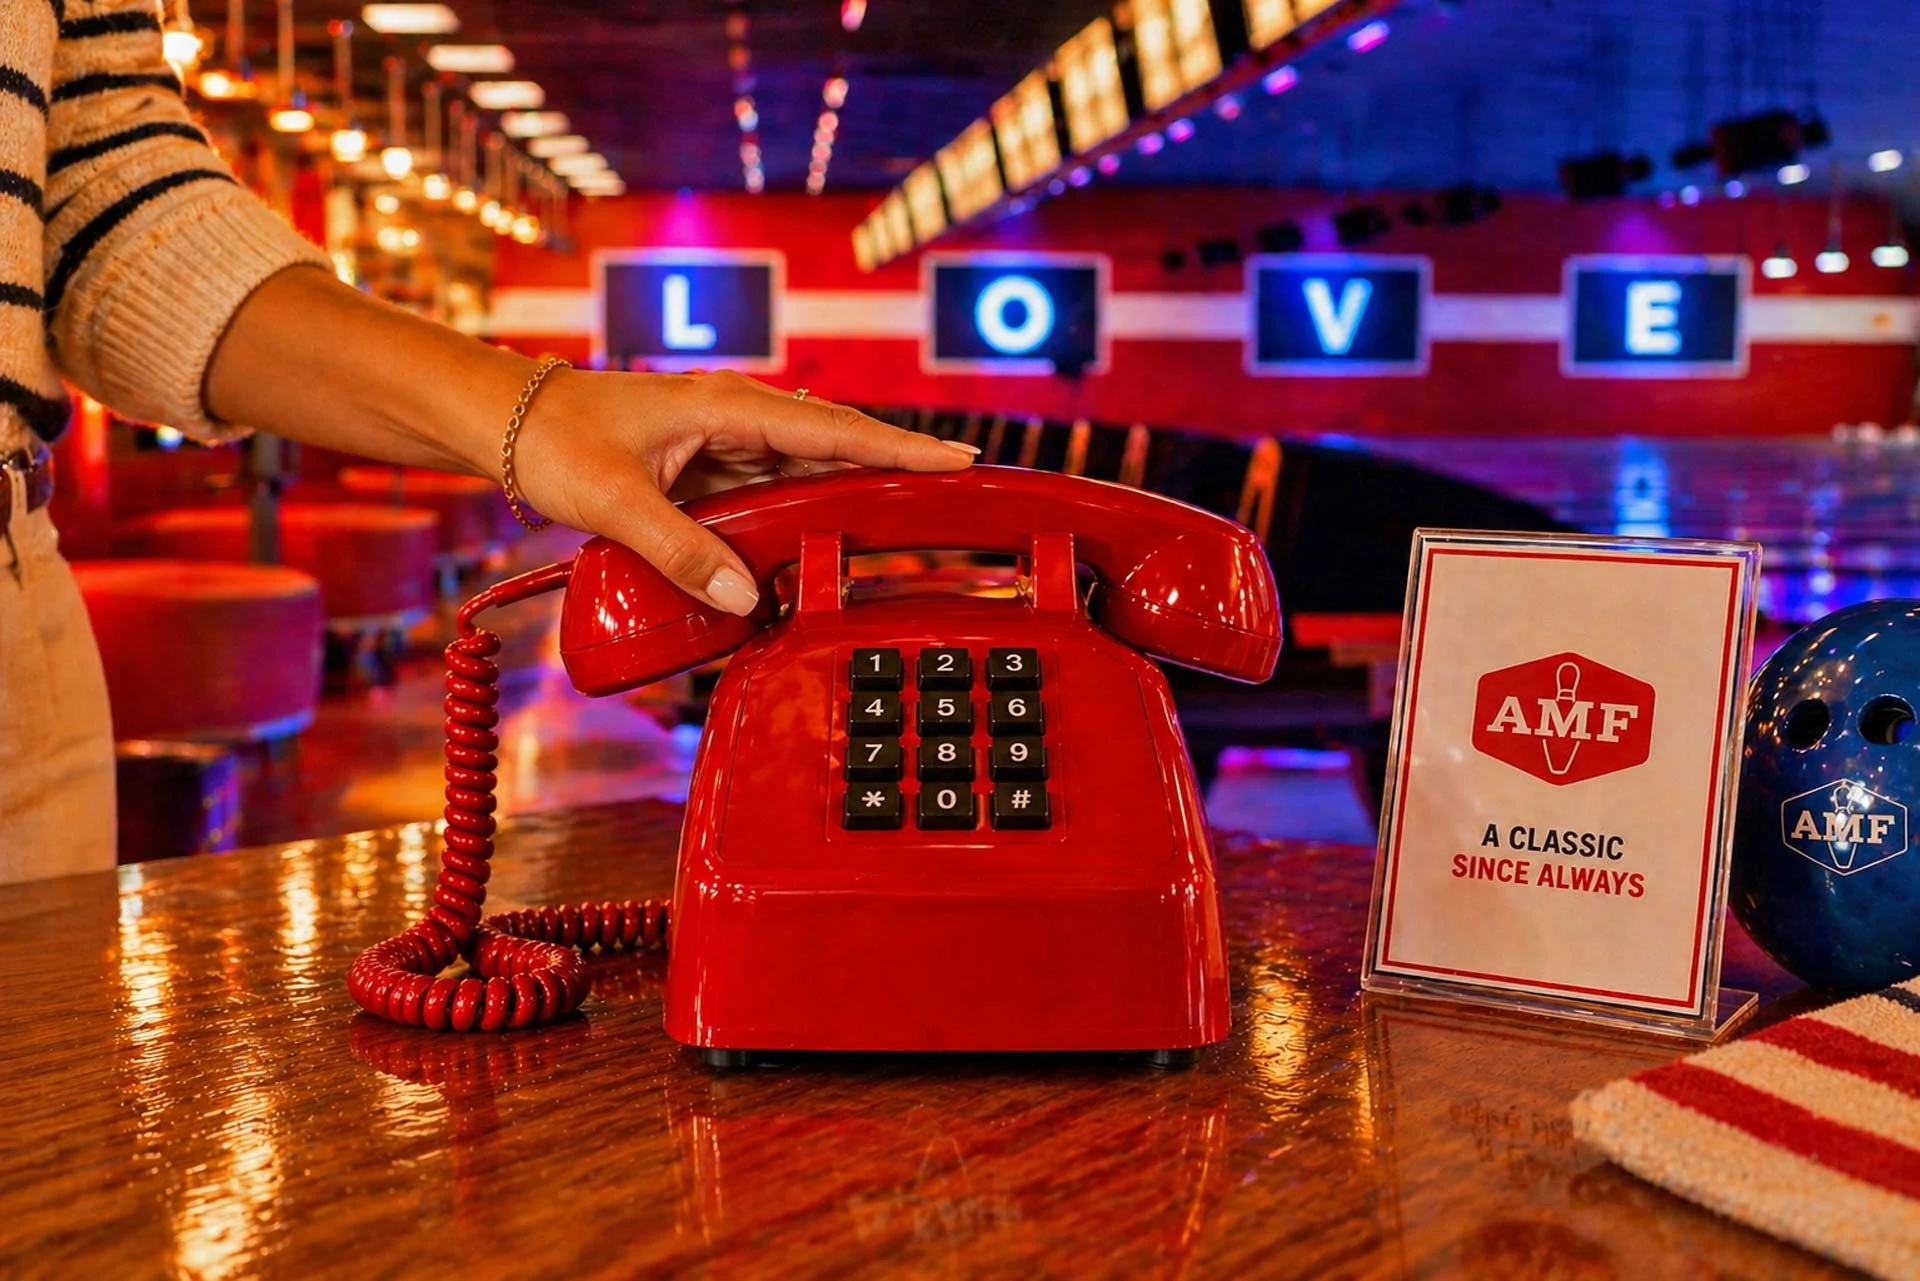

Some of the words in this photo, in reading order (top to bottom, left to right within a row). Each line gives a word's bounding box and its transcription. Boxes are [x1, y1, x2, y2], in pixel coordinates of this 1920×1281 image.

[869, 654, 881, 672] 1
[936, 654, 954, 672] 2
[1005, 654, 1023, 672] 3
[864, 698, 885, 717] 4
[937, 698, 955, 717] 5
[1007, 698, 1027, 717] 6
[1486, 696, 1639, 743] AMF
[865, 743, 883, 763] 7
[937, 743, 957, 762] 8
[1009, 743, 1028, 762] 9
[936, 789, 957, 809] 0
[1790, 810, 1895, 844] AMF
[1481, 823, 1500, 848] A
[1508, 826, 1624, 861] CLASSIC
[1451, 853, 1530, 885] SINCE
[1536, 863, 1645, 898] ALWAYS
